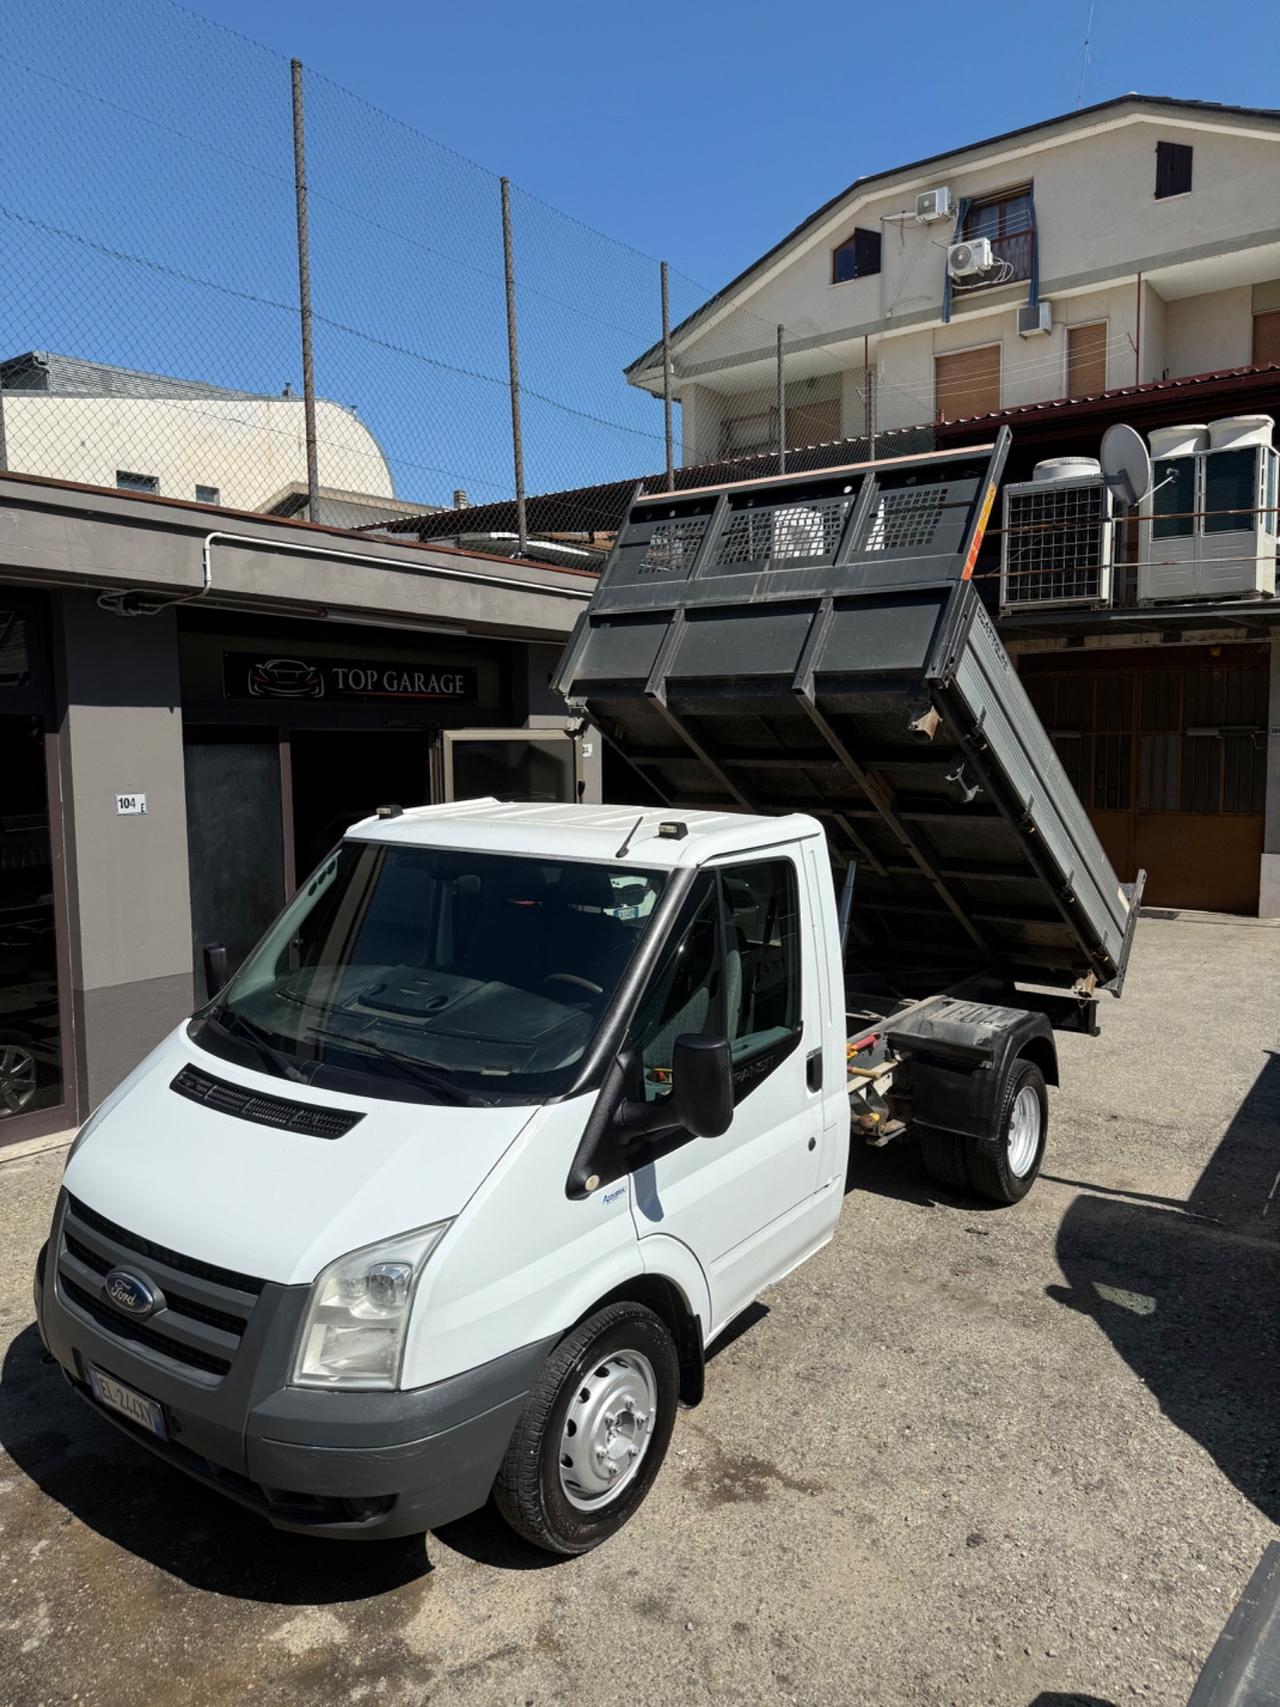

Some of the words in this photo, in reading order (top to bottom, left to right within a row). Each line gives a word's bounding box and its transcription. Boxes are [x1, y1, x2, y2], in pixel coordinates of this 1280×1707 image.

[332, 667, 378, 690] TOP
[383, 670, 465, 694] GARAGE
[118, 797, 136, 809] 104
[111, 1279, 137, 1306] Ford
